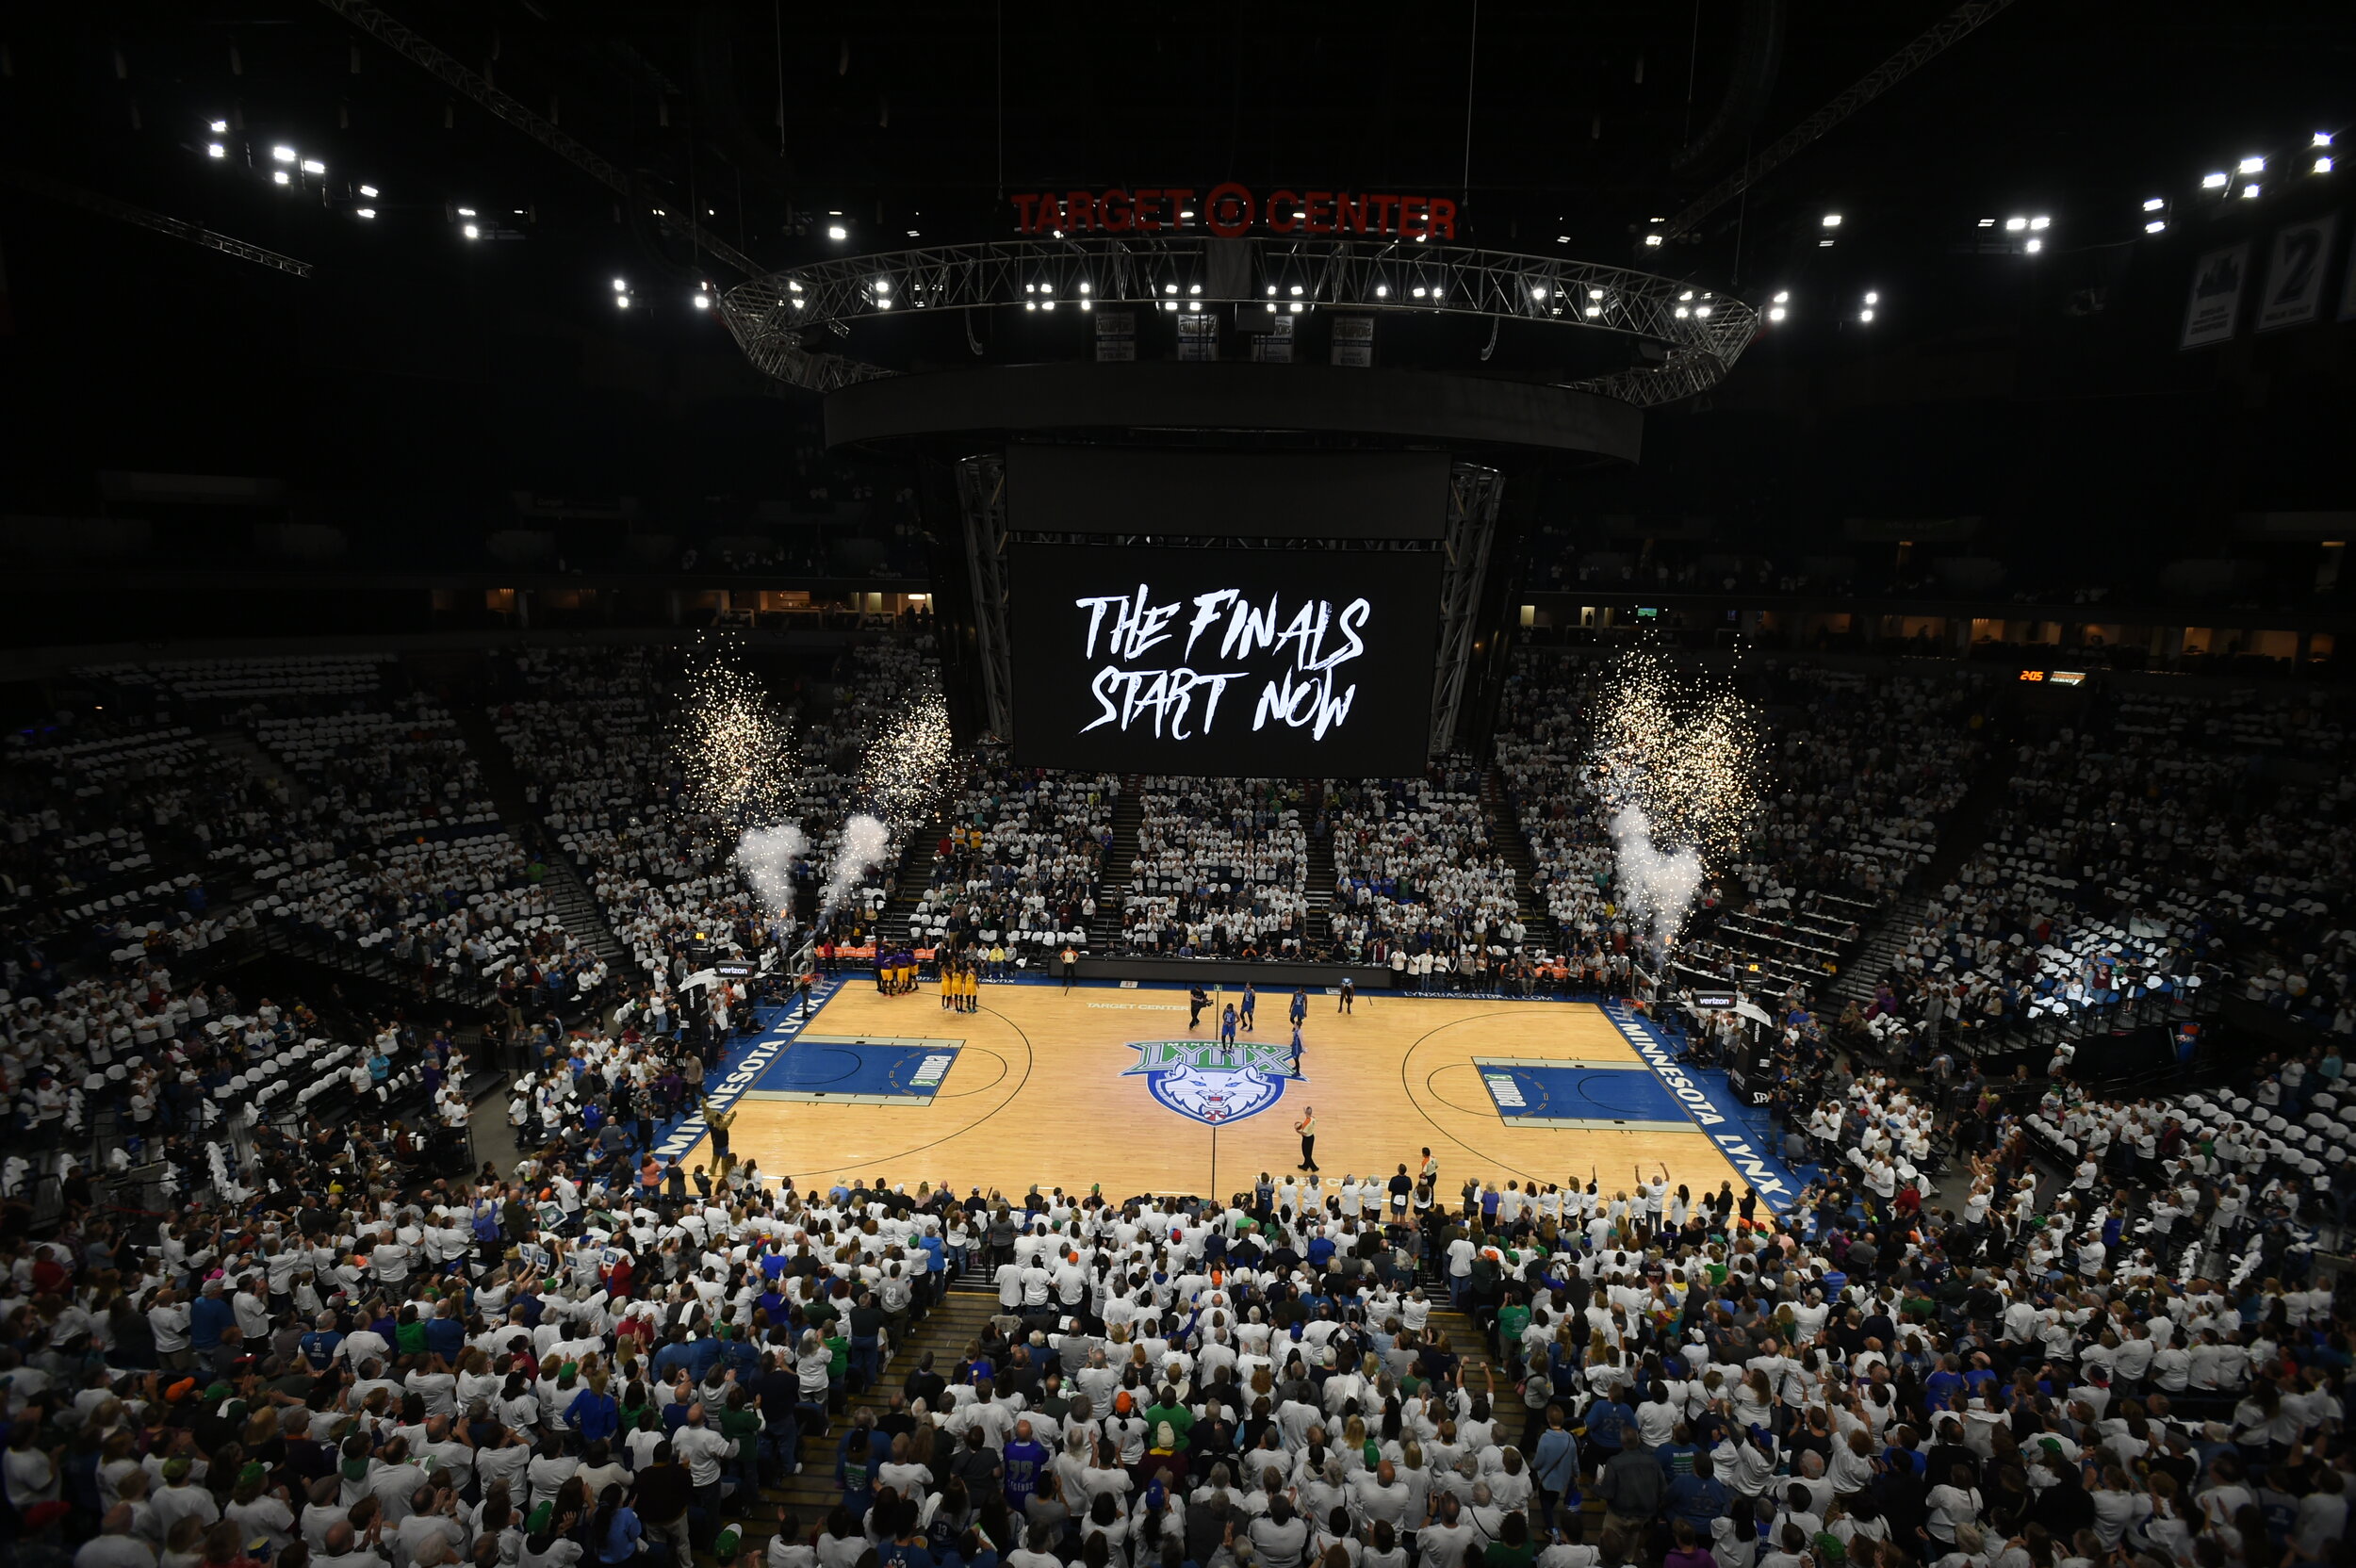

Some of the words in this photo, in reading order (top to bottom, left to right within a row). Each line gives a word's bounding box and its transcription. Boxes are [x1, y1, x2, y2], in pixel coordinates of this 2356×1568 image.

[1010, 189, 1194, 235] TARGET
[1265, 190, 1457, 240] CENTER
[2273, 229, 2322, 305] 2
[1075, 583, 1182, 662] THE
[1185, 588, 1370, 672] FINALS
[1077, 665, 1251, 741] START
[1252, 664, 1356, 742] NOW
[719, 967, 748, 975] verizon
[1086, 1002, 1136, 1011] TARGET
[1137, 1003, 1191, 1012] CENTER
[1699, 997, 1730, 1005] verizon
[1137, 1042, 1293, 1075] LYNX
[1619, 1022, 1726, 1126] MINNESOTA
[1714, 1134, 1792, 1196] LYNX
